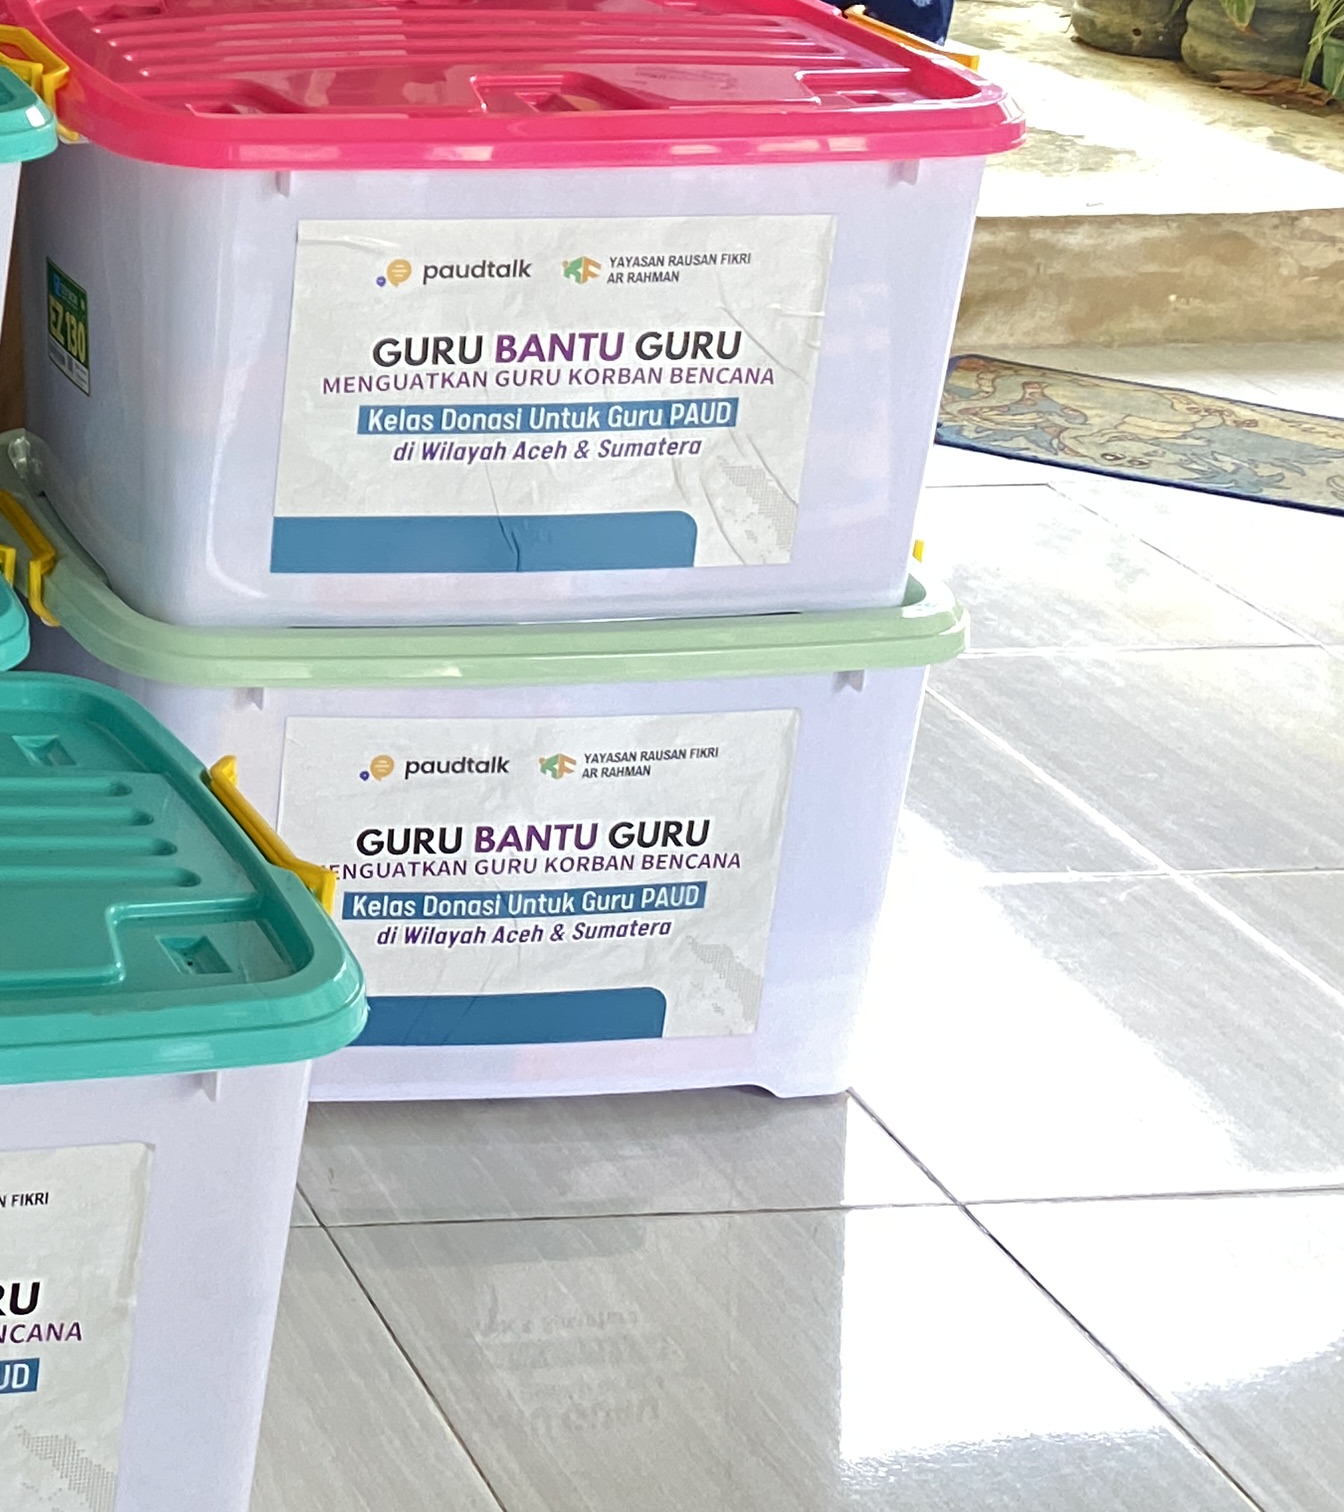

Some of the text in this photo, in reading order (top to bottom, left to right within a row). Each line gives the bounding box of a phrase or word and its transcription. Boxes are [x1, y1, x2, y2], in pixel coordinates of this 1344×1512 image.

[422, 259, 532, 285] paudtalk
[609, 252, 751, 268] YAYASAN RAUSAN FIKRI
[607, 270, 680, 283] AR RAHMAN
[372, 330, 742, 367] GURU BANTU GURU
[322, 366, 775, 395] MENGUATKAN GURU KORBAN BENCANA
[367, 402, 731, 432] Kelas Donasi Untuk Guru PAUD
[393, 436, 701, 465] di Wilayah Aceh & Sumatera
[405, 756, 510, 780] paudtalk
[356, 819, 710, 856] GURU BANTU GURU
[326, 853, 741, 880] ENGUATKAN GURU KORBAN BENCANA
[12, 1193, 49, 1208] FIKRI
